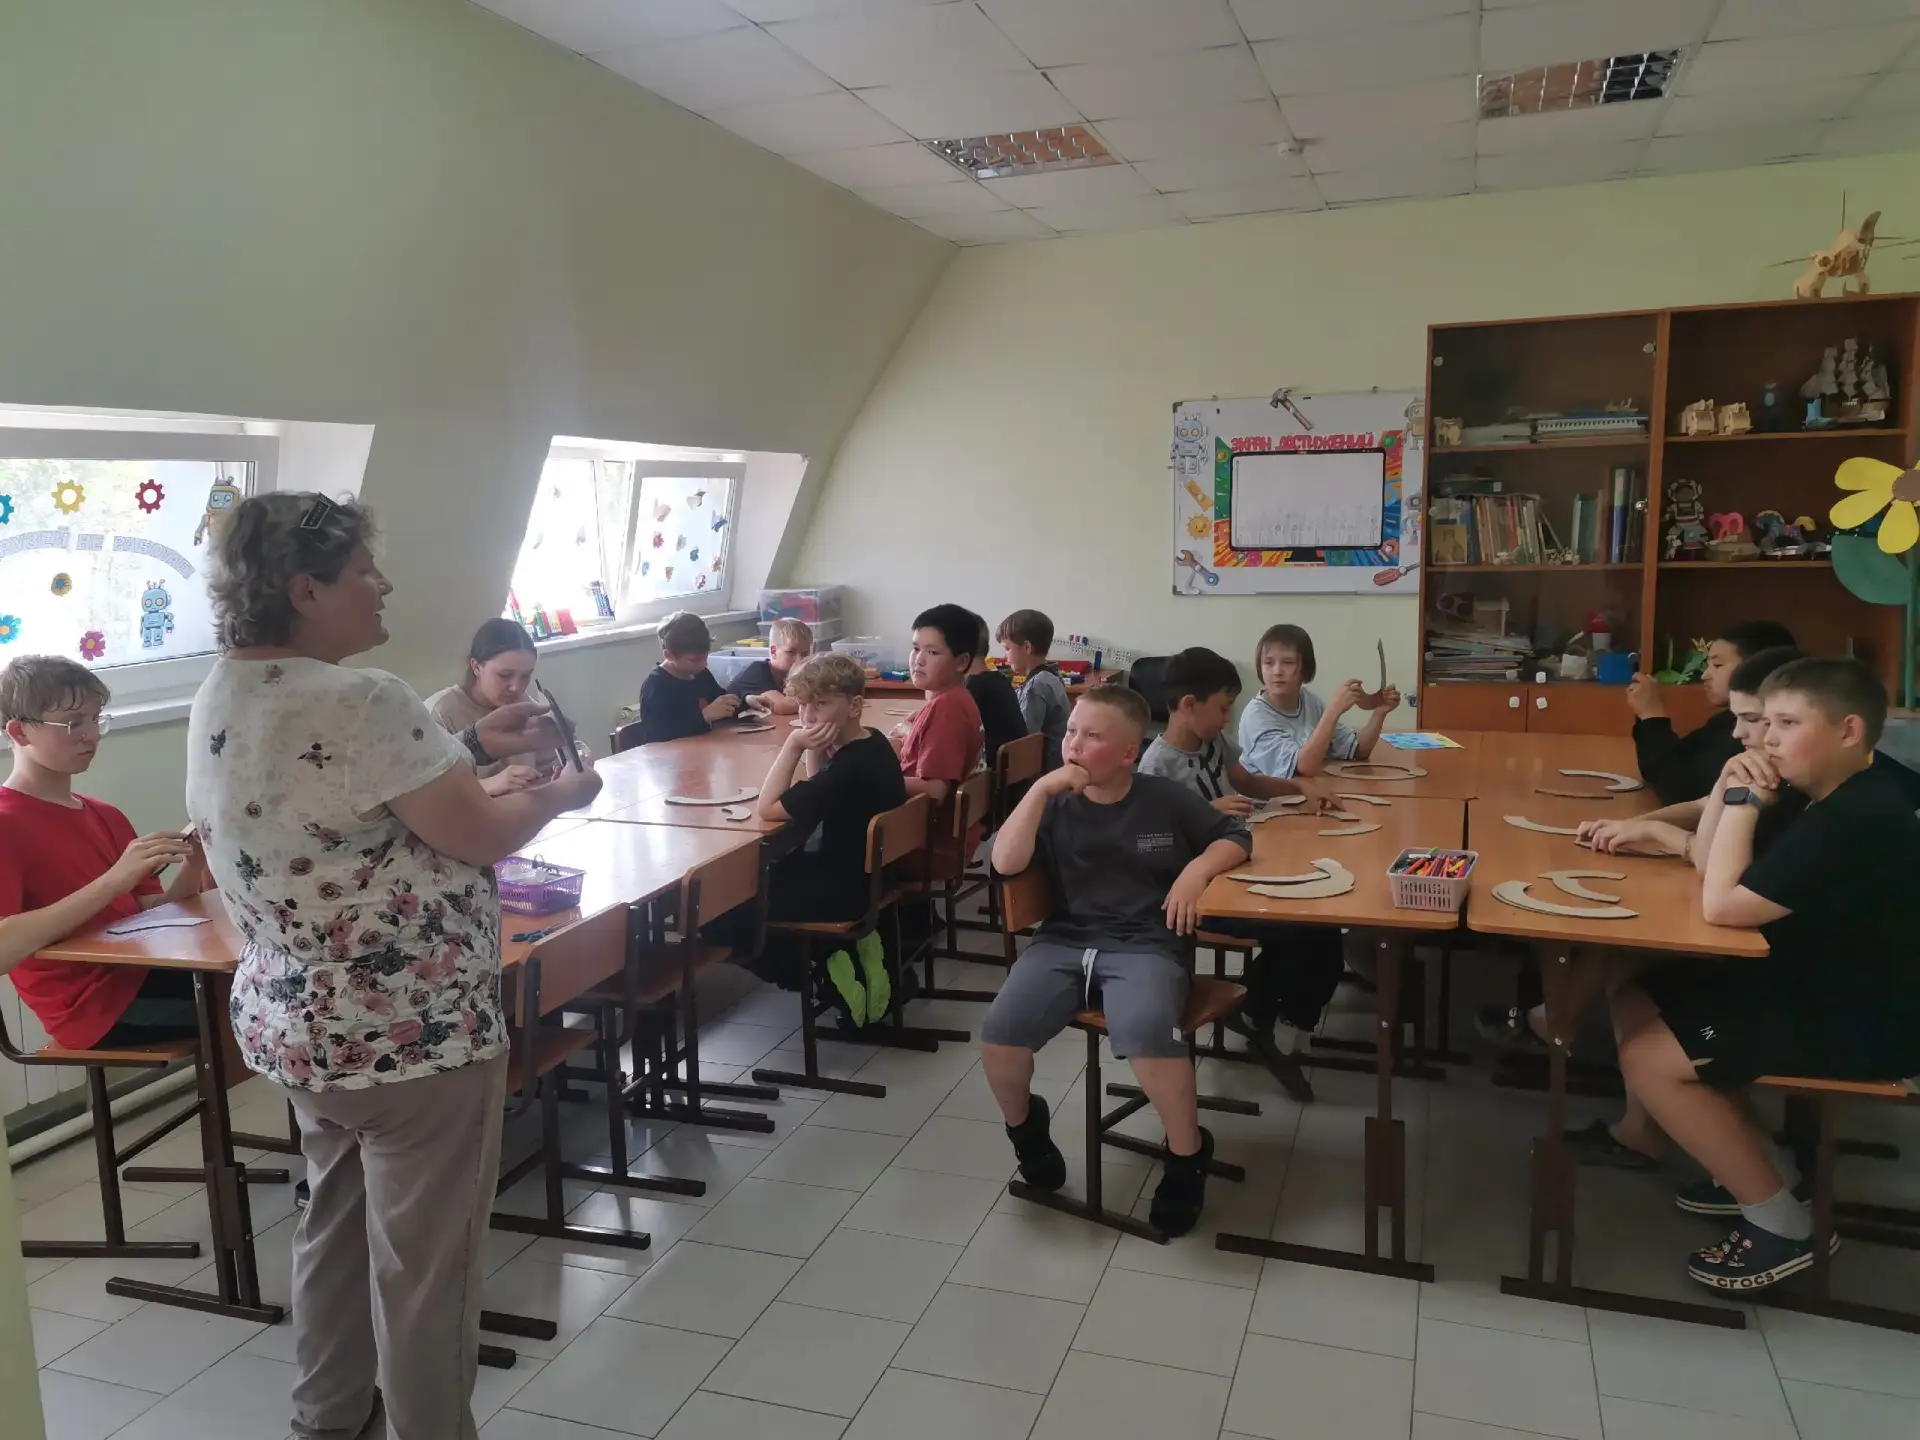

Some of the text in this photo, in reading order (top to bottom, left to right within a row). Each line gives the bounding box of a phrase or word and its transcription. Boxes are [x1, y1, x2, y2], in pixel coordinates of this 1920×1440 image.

[1230, 432, 1375, 451] ЭКРАН ДОСТИЖЕНИЙ
[76, 533, 105, 551] НЕ
[1716, 1271, 1774, 1289] crocs
